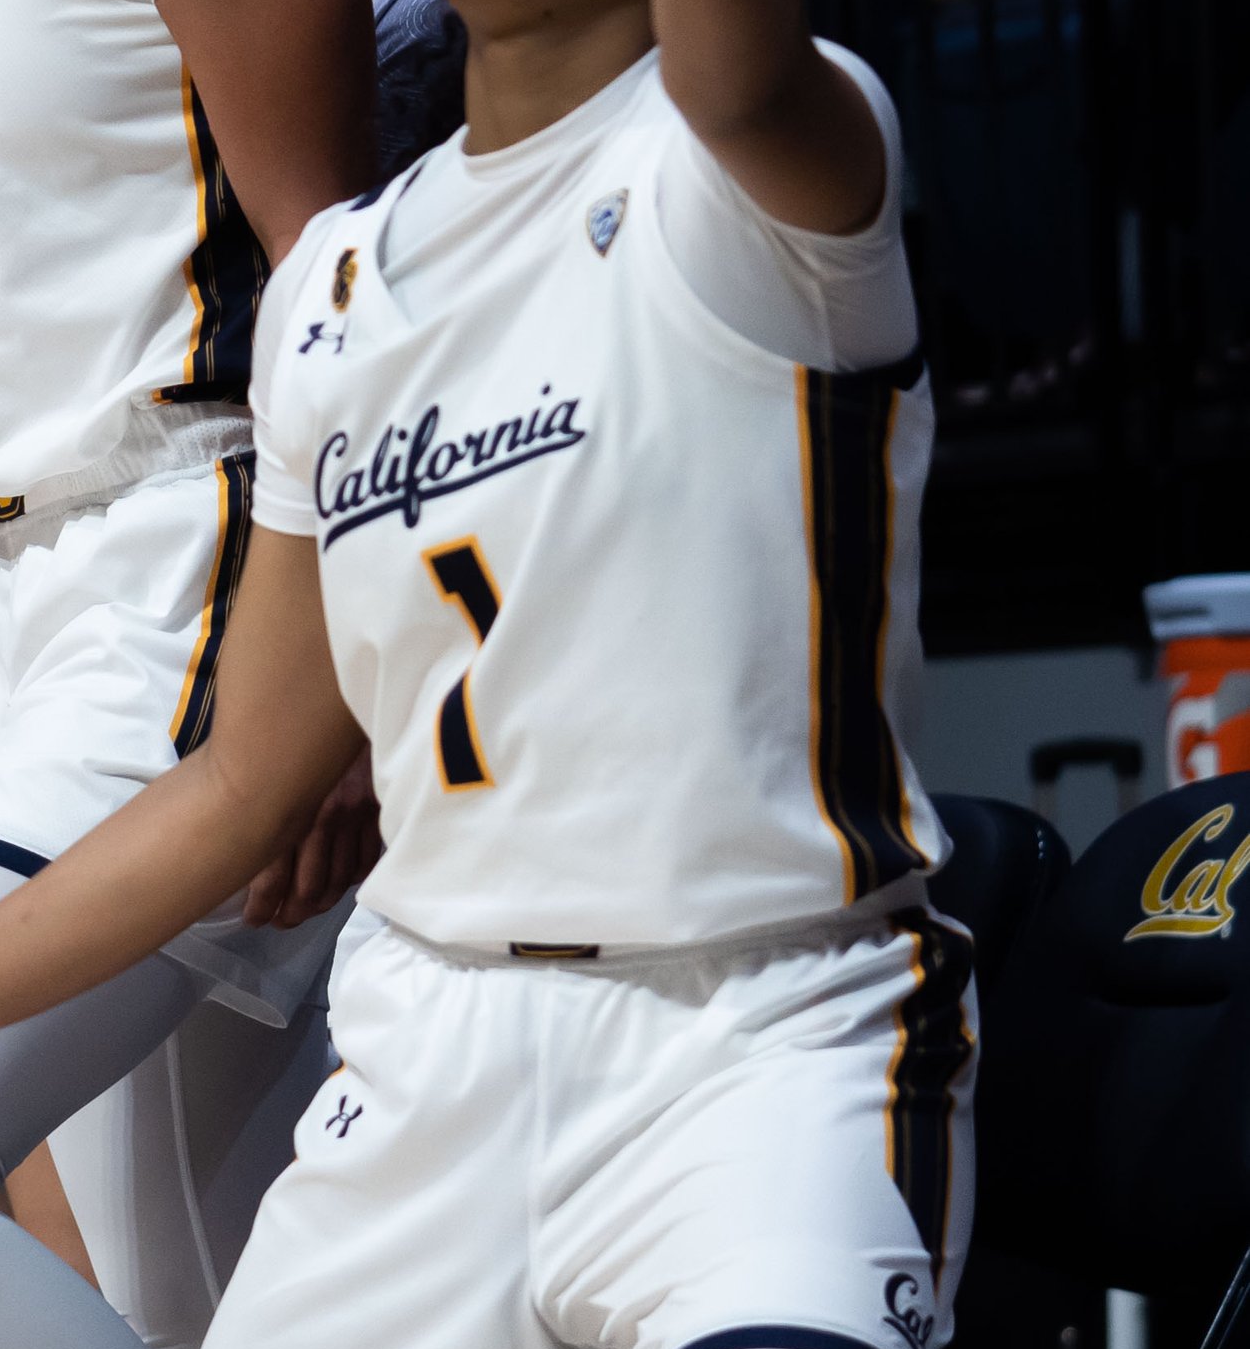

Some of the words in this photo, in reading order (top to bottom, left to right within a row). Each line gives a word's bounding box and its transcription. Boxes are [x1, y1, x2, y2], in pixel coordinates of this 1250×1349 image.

[314, 384, 587, 554] California
[420, 534, 503, 794] 1
[1122, 802, 1250, 943] Cal
